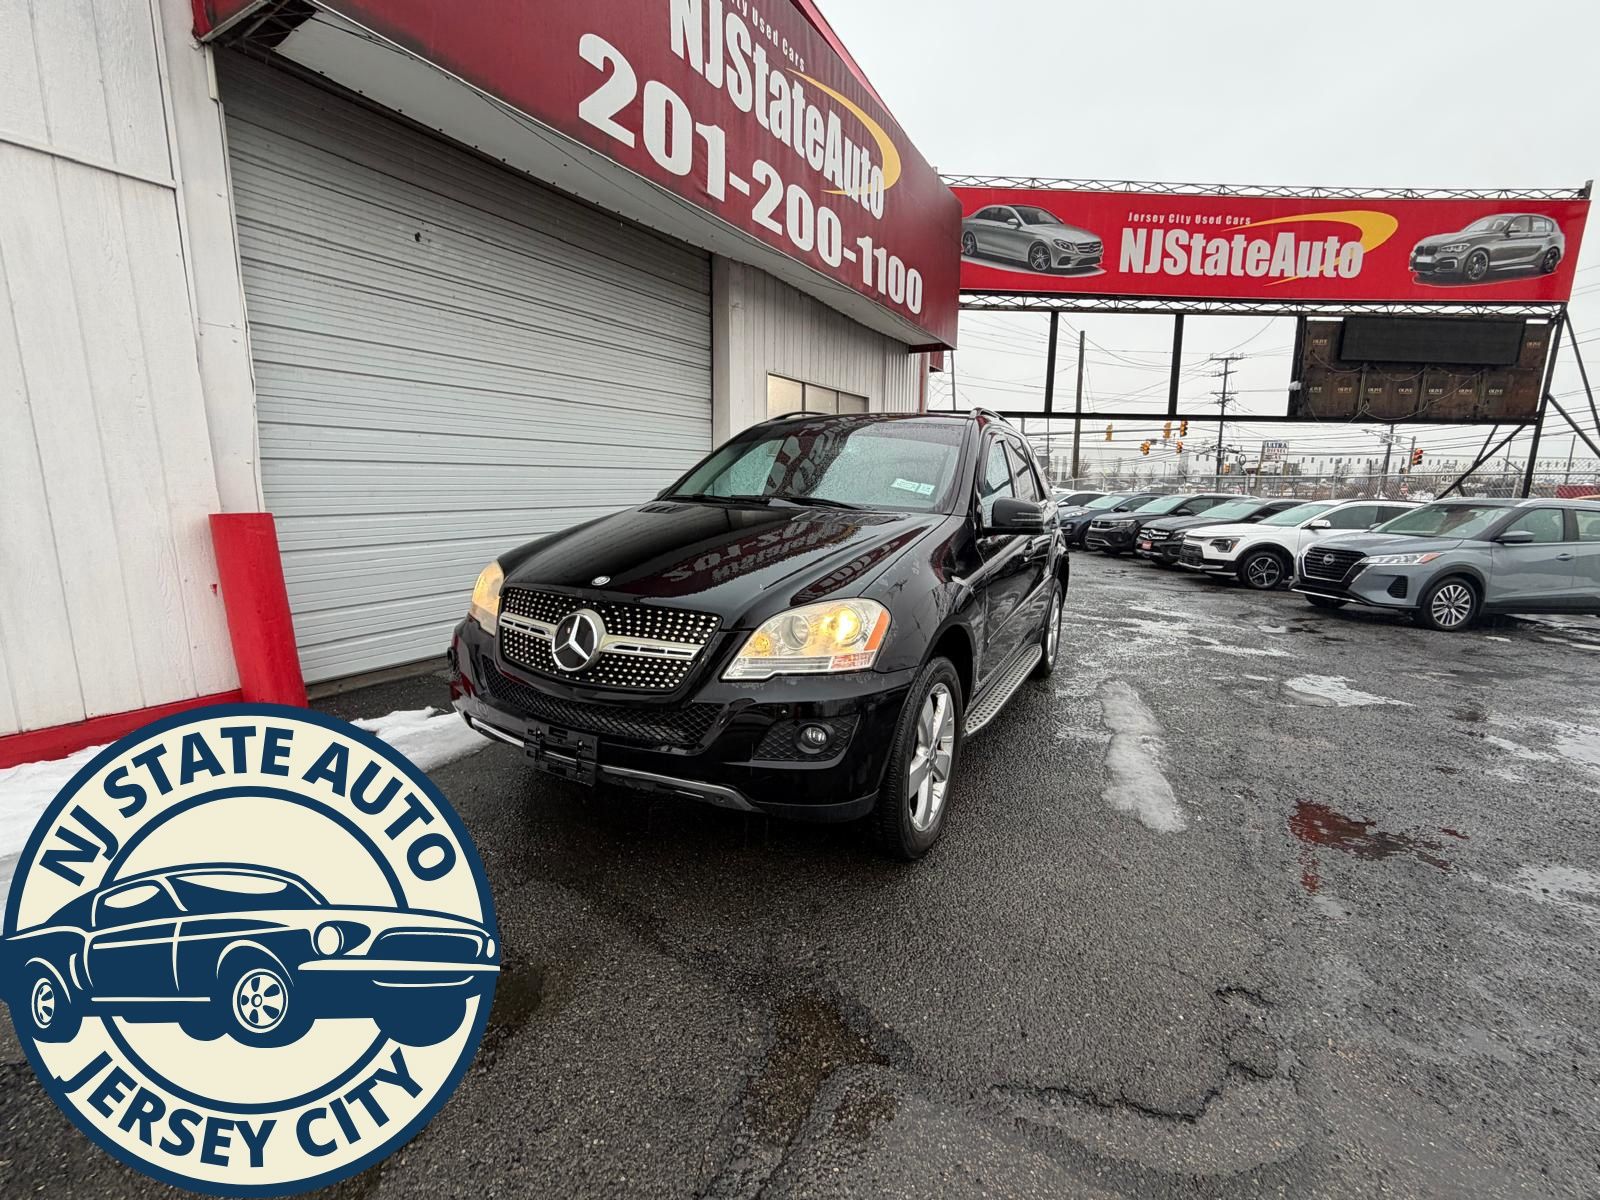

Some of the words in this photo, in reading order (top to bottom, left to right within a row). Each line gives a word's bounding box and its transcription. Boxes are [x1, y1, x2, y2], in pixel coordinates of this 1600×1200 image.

[752, 6, 779, 48] Used
[782, 37, 805, 72] Cars
[669, 0, 885, 220] NJStateAuto
[578, 33, 923, 315] 201-200-1100
[1127, 211, 1165, 224] Jersey
[1168, 213, 1192, 225] City
[1194, 214, 1222, 225] Used
[1225, 215, 1252, 226] Cars
[1118, 227, 1364, 279] NJStateAuto
